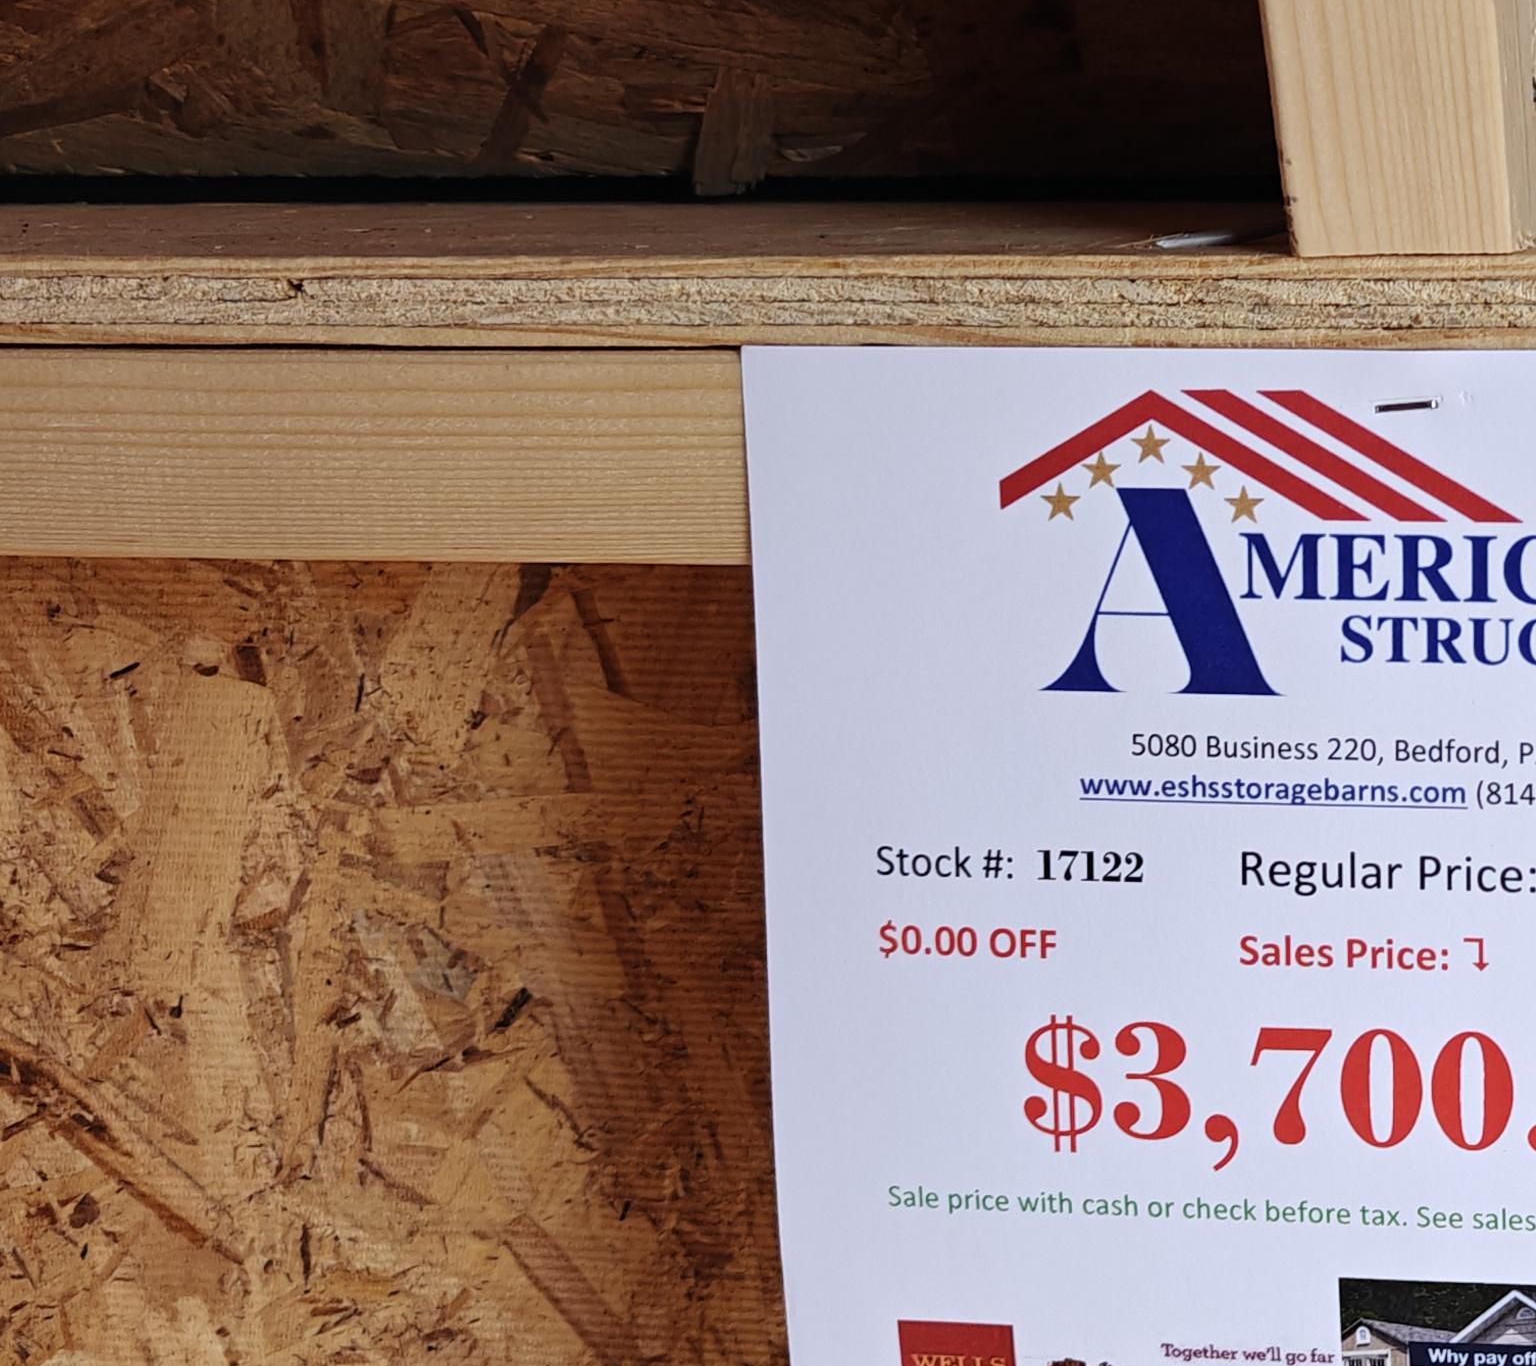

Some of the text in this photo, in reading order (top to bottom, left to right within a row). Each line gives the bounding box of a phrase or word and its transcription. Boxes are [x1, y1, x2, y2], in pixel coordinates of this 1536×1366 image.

[1132, 734, 1196, 757] 5080
[1207, 736, 1318, 760] Business
[1328, 738, 1383, 766] 220,
[1395, 739, 1507, 769] Bedford,
[1079, 774, 1468, 810] www.eshsstoragebarns.com
[877, 846, 1143, 883] Stock #: 17122
[1242, 851, 1402, 896] Regular
[1420, 856, 1536, 893] Price:
[880, 920, 1056, 959] $0.00 OFF
[1240, 935, 1448, 971] Sales Price:
[889, 1186, 938, 1208] Sale
[948, 1189, 1009, 1214] price
[1018, 1192, 1072, 1213] with
[1083, 1194, 1138, 1216] cash
[1148, 1201, 1174, 1218] or
[1183, 1197, 1256, 1220] check
[1266, 1200, 1350, 1224] before
[1360, 1206, 1407, 1226] tax.
[1417, 1206, 1463, 1228] See
[1473, 1208, 1536, 1231] sales
[1161, 1343, 1335, 1366] Together we'll go far
